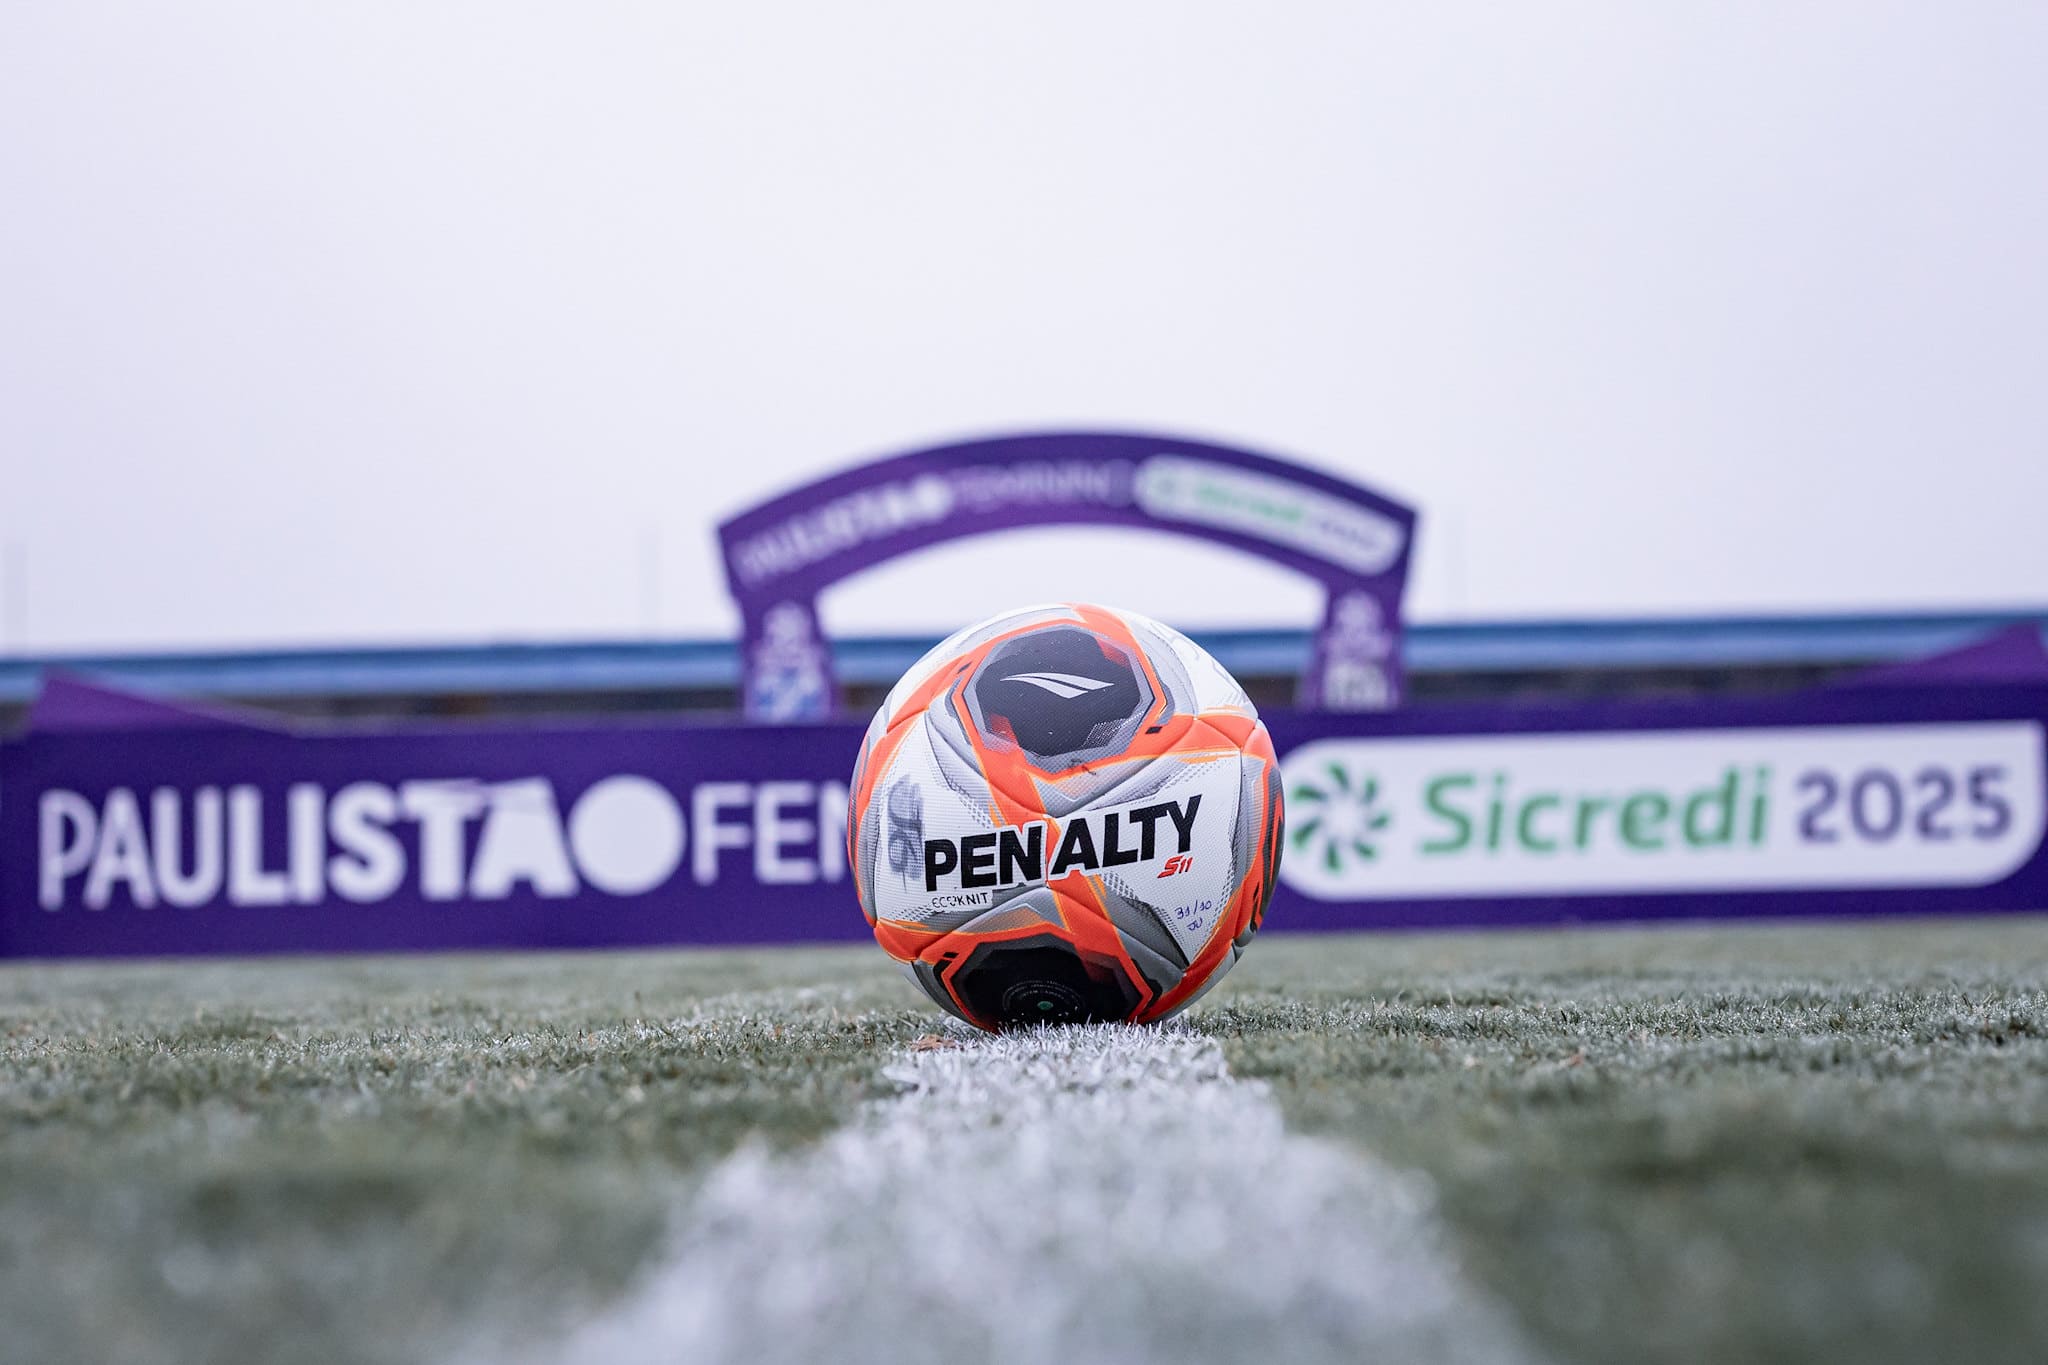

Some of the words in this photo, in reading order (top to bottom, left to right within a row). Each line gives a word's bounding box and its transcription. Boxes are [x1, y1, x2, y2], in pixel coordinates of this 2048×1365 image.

[924, 794, 1203, 892] PENALTY
[1419, 763, 1770, 856] Sicredi
[1798, 766, 2013, 845] 2025
